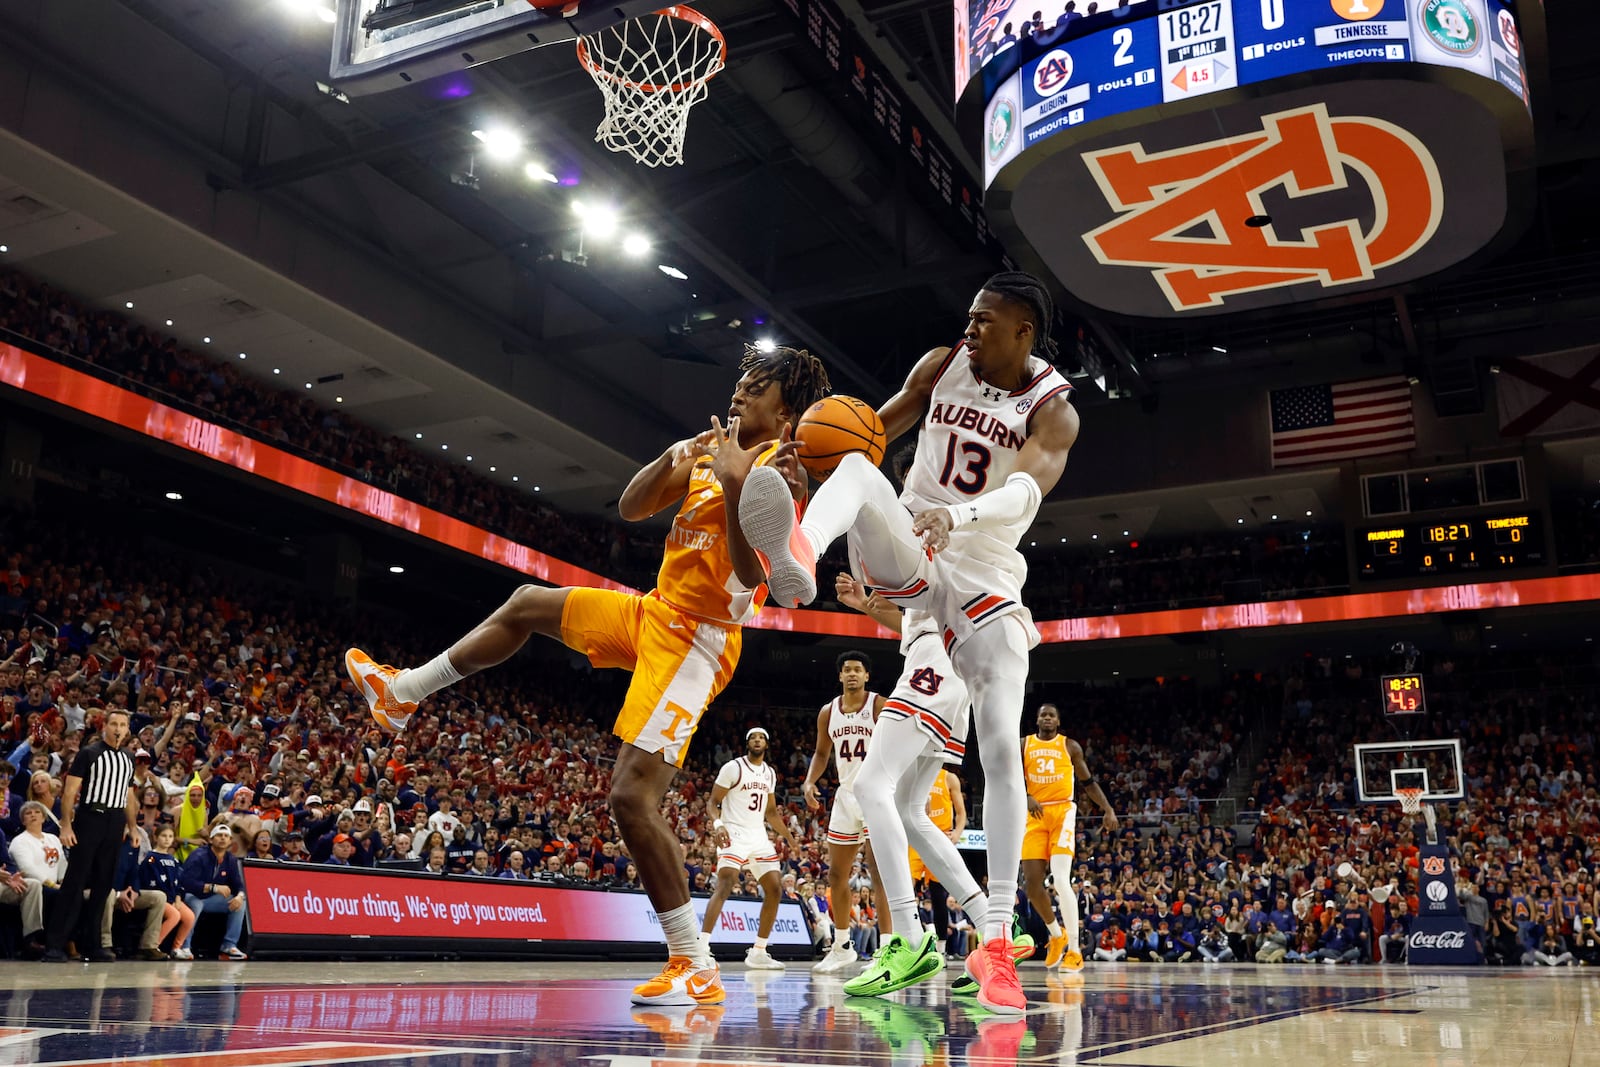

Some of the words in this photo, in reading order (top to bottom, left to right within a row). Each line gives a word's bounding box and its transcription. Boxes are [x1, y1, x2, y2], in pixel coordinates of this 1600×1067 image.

[1166, 2, 1222, 42] 18:27
[1334, 24, 1388, 40] TENNESSEE
[1112, 27, 1135, 67] 2
[1192, 40, 1217, 57] HALF
[1266, 36, 1306, 53] FOULS
[1327, 47, 1385, 62] TIMEOUTS
[1391, 46, 1398, 57] 4
[1097, 77, 1133, 93] FOULS
[1141, 71, 1149, 83] 0
[1191, 68, 1209, 83] 4.5
[1040, 93, 1069, 115] AUBURN
[1028, 115, 1069, 141] TIMEOUTS
[930, 402, 1028, 453] AUBURN
[938, 431, 992, 496] 13
[1486, 516, 1529, 530] TENNESSEE
[1367, 529, 1405, 541] AUBURN
[1430, 524, 1470, 542] 18:27
[1510, 528, 1520, 542] 0
[1389, 540, 1398, 554] 2
[1424, 555, 1432, 566] 0
[1389, 677, 1420, 691] 18:27
[1387, 691, 1416, 711] 4.3
[661, 700, 694, 742] T
[832, 725, 873, 739] AUBURN
[839, 738, 867, 763] 44
[1028, 748, 1063, 760] TENNESSEE
[1035, 757, 1056, 775] 34
[1027, 771, 1065, 785] VOLUNTEERS
[747, 793, 764, 813] 31
[267, 887, 300, 914] You
[303, 889, 323, 915] do
[325, 897, 359, 921] your
[362, 893, 405, 923] thing.
[450, 901, 473, 925] got
[472, 904, 497, 926] you
[497, 902, 547, 923] covered.
[1515, 902, 1530, 917] A
[720, 911, 746, 932] Alfa
[744, 911, 800, 934] Insance
[1409, 930, 1467, 949] Coca-Cola
